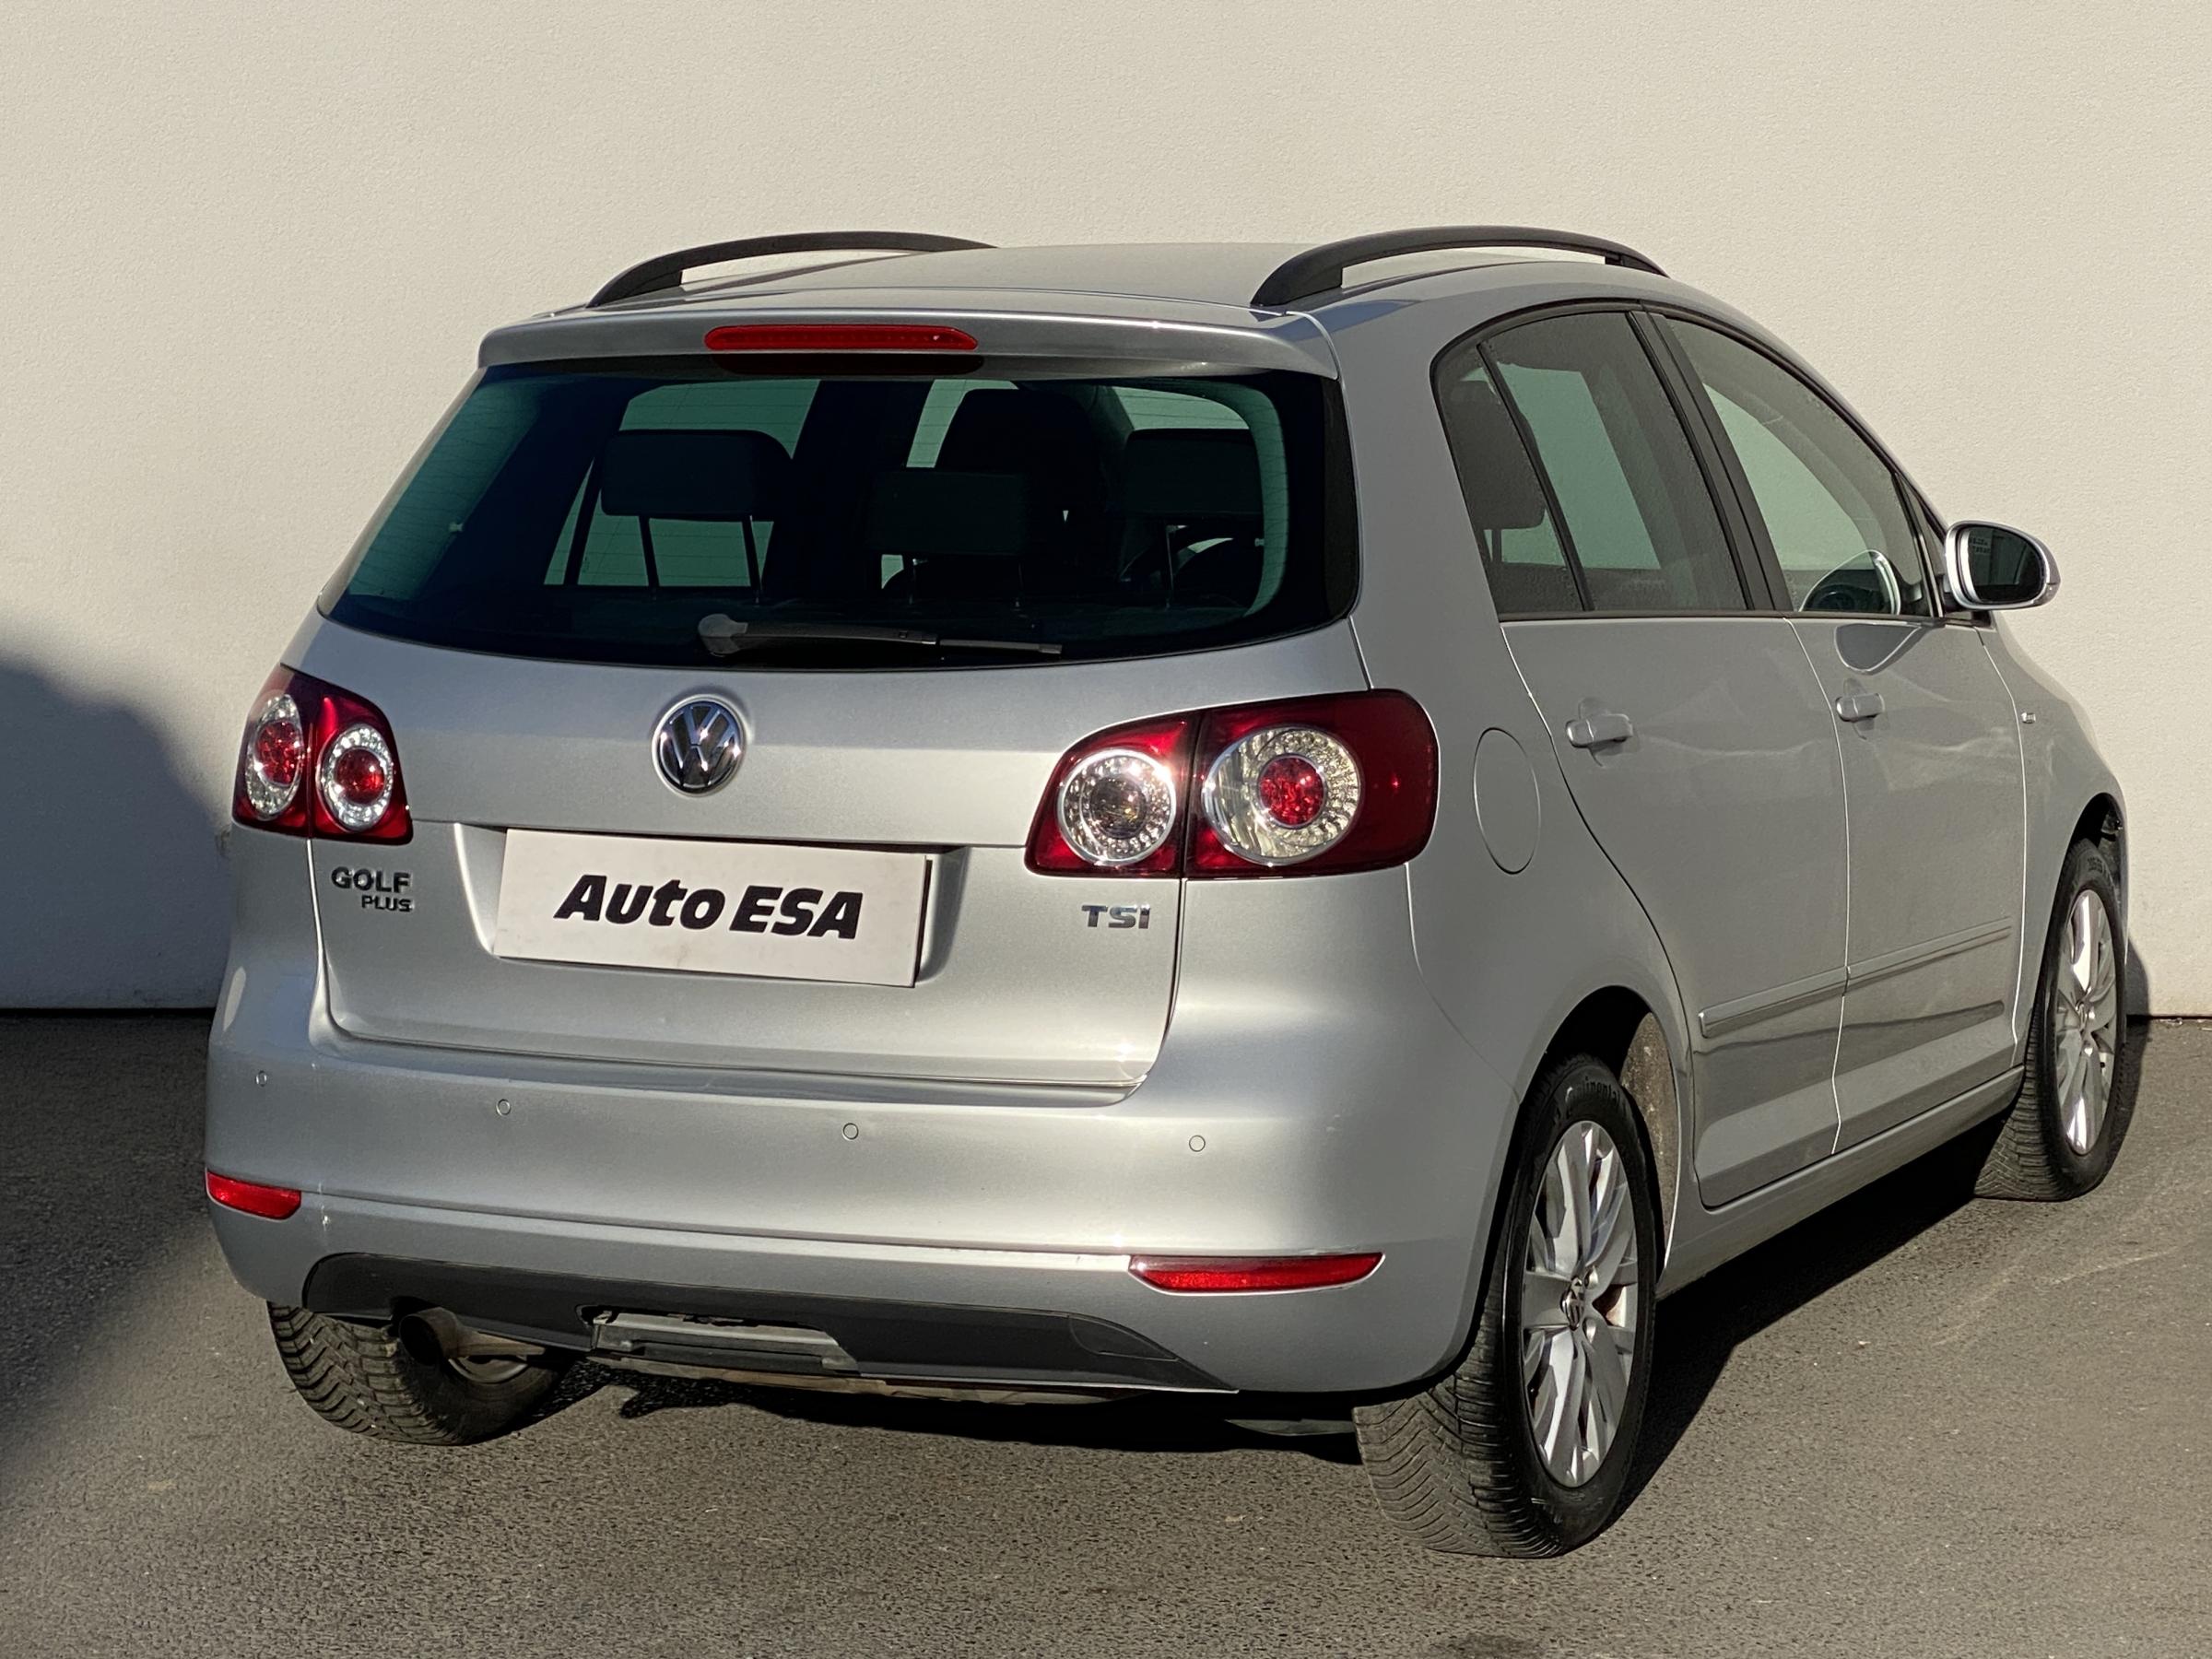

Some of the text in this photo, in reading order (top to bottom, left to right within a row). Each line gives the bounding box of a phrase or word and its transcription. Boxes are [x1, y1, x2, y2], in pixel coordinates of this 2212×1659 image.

[331, 866, 411, 893] GOLF
[361, 894, 413, 912] PLUS
[553, 874, 864, 939] Auto ESA
